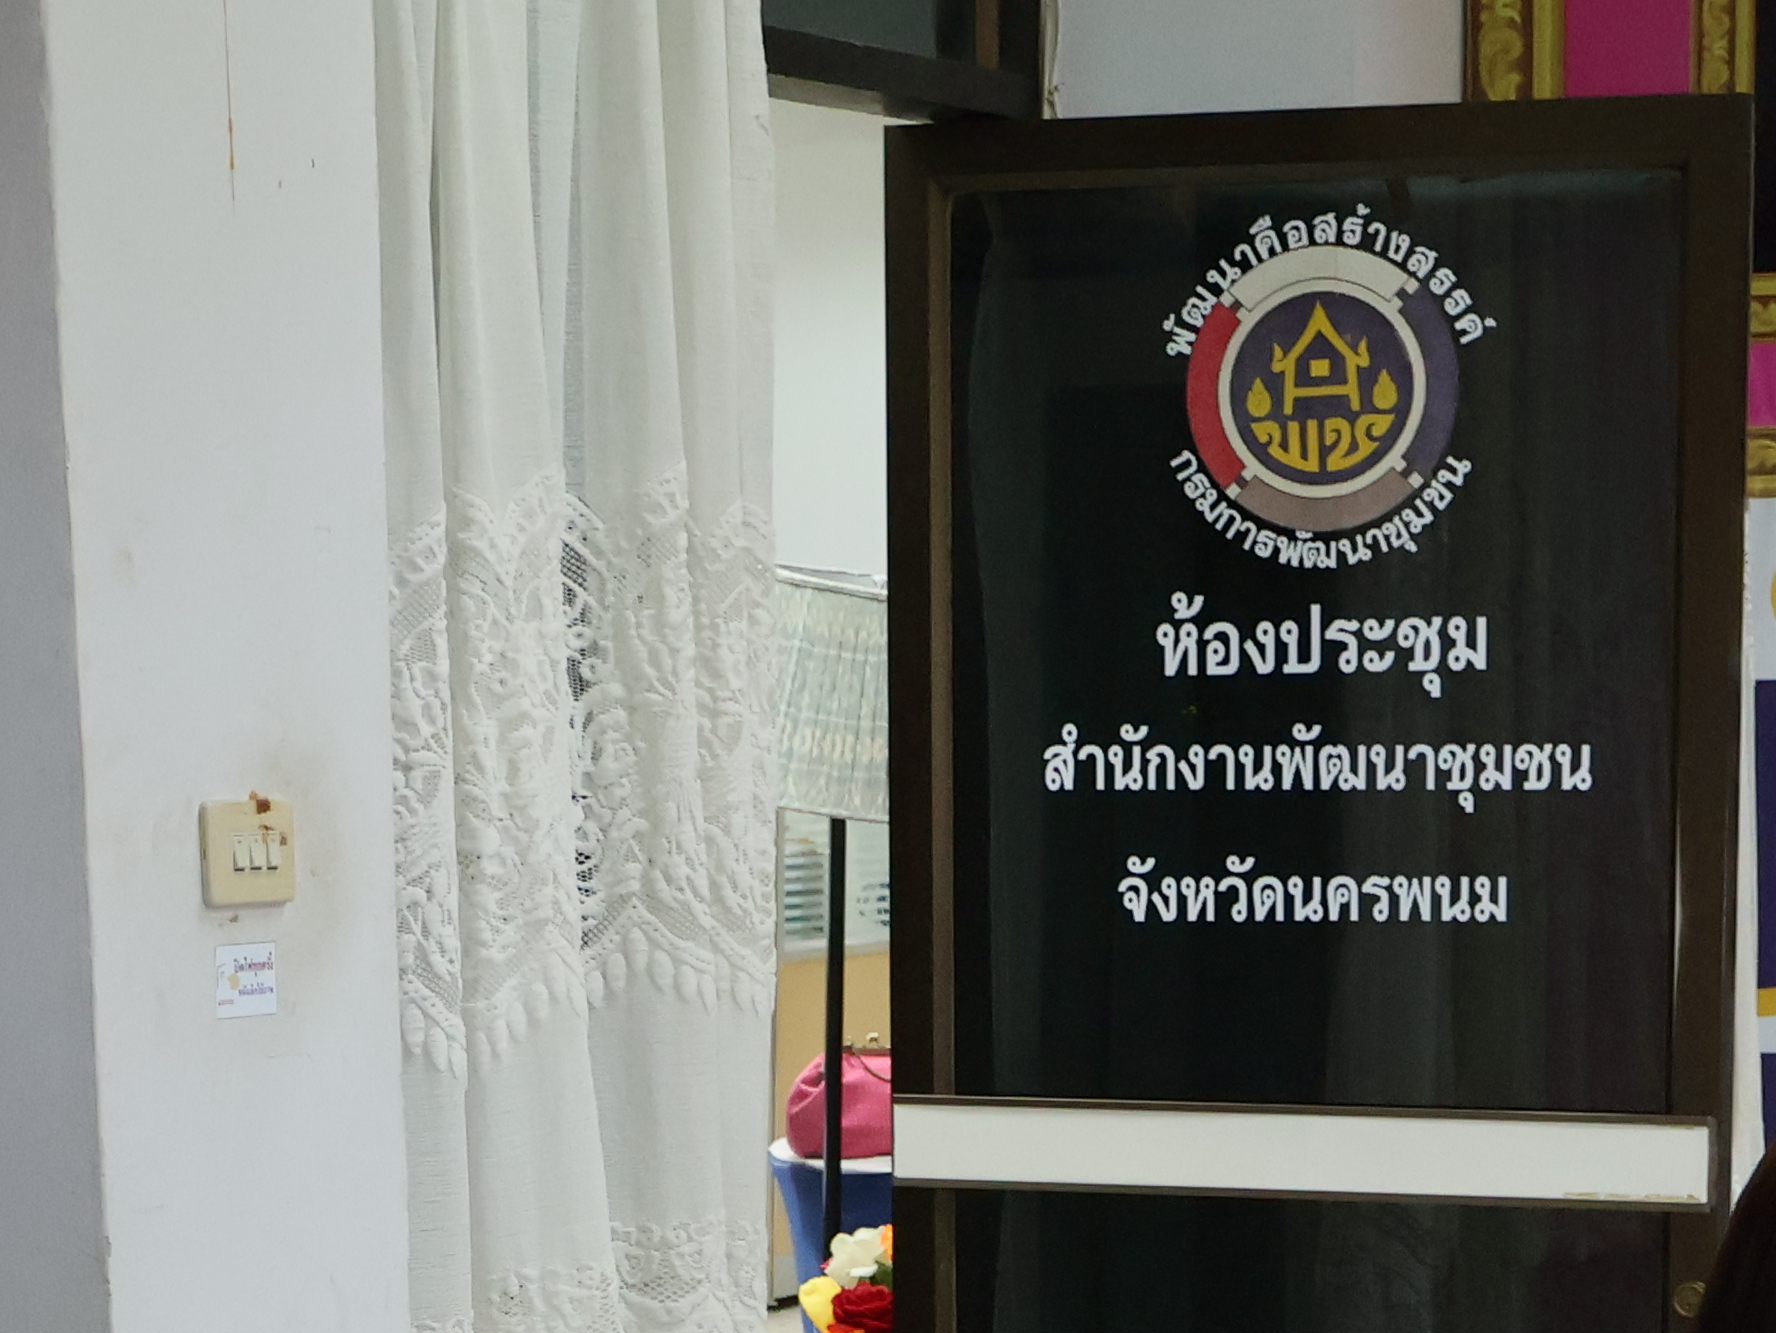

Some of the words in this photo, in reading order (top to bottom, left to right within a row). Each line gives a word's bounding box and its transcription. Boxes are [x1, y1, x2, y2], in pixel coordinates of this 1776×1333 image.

[1165, 203, 1497, 358] พัฒนาคือสร้างสรรค์
[1170, 449, 1472, 570] กรมการพัฒนาชุมชน
[1155, 592, 1489, 697] ห้องประชุม
[1042, 723, 1593, 813] สำนักงานพัฒนาชุมชน
[1117, 855, 1509, 924] จังหวัดนครพนม
